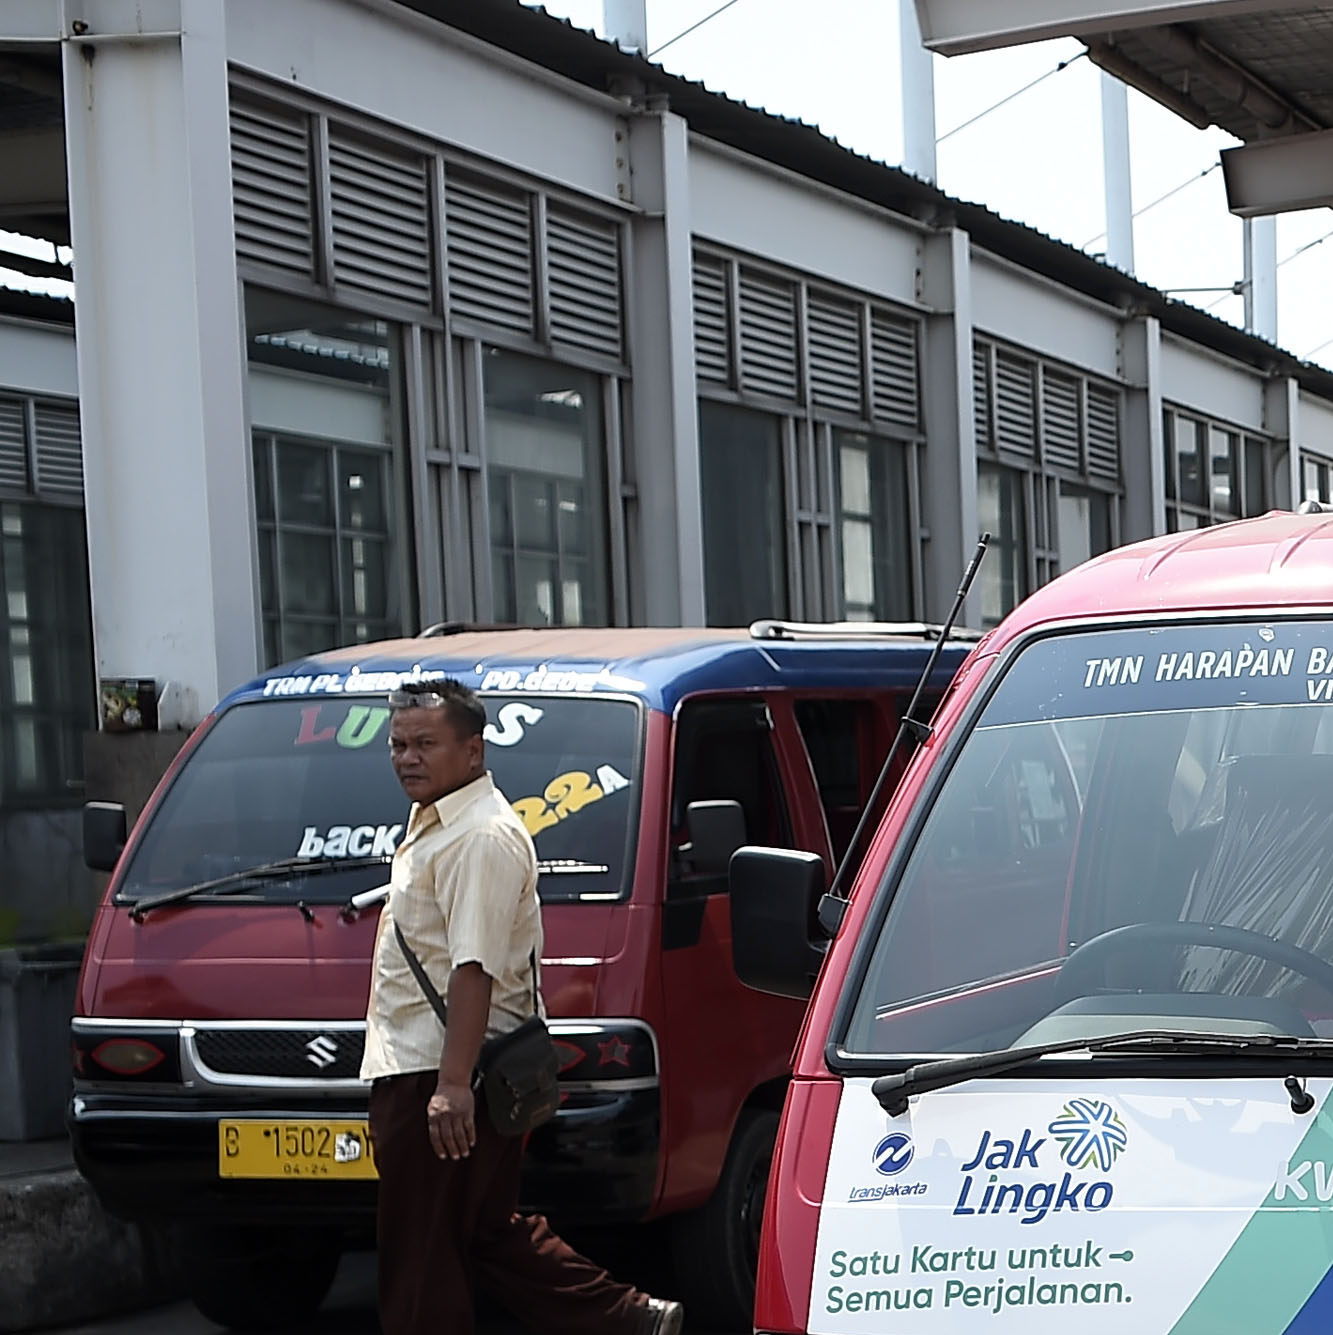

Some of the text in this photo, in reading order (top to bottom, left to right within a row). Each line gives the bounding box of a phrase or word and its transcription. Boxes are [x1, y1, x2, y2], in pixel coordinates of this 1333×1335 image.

[1084, 656, 1144, 687] TMN
[1155, 649, 1295, 682] HARAPAN
[273, 1127, 330, 1158] 1502
[961, 1129, 1048, 1171] Jak
[848, 1182, 928, 1202] transjakarta
[952, 1172, 1114, 1224] Lingko
[829, 1240, 1103, 1277] Satu Kartu untuk
[826, 1276, 1133, 1313] Semua Perjalanan.
